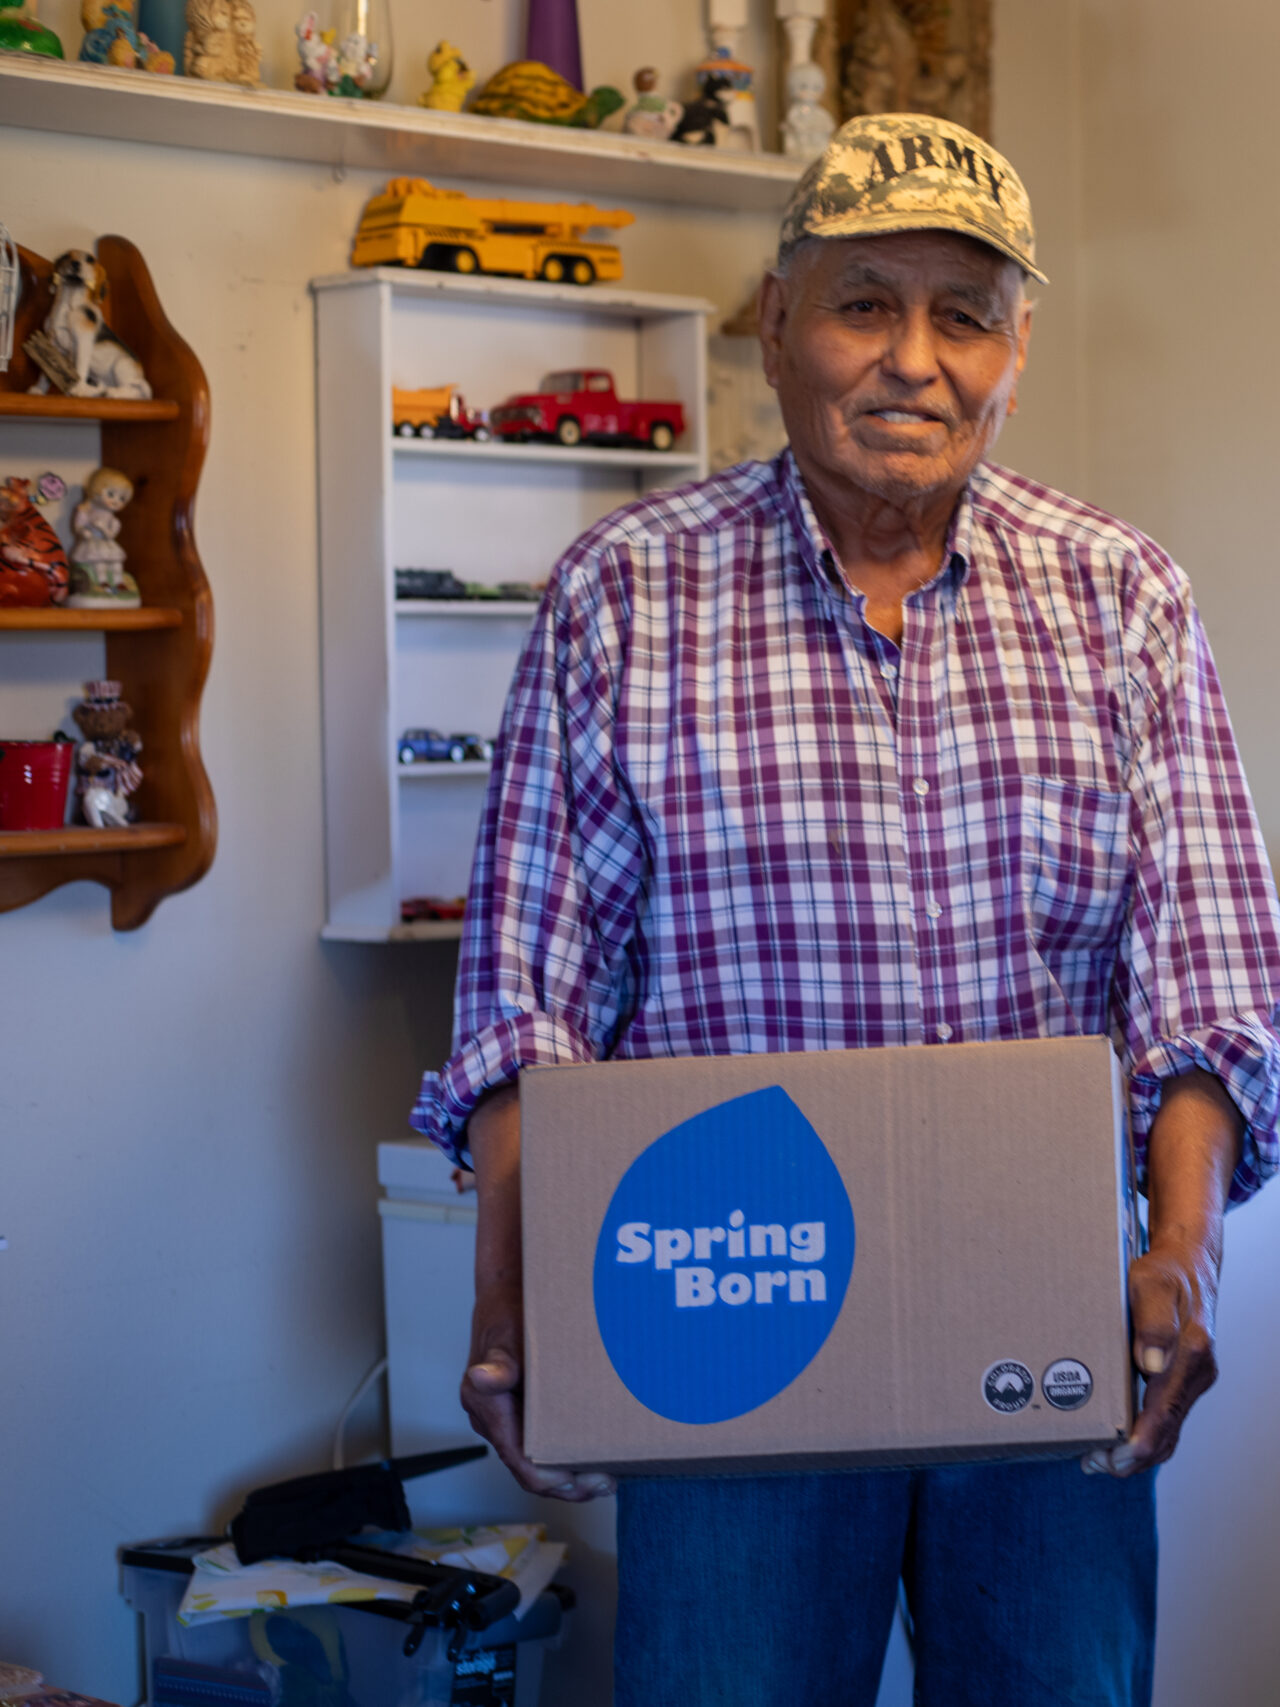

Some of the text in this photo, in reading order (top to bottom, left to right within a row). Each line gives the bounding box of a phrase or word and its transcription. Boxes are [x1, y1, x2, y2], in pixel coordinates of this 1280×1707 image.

[867, 134, 1006, 207] ARMY
[616, 1209, 826, 1271] Spring
[674, 1266, 827, 1308] Born
[1052, 1370, 1081, 1383] USDA
